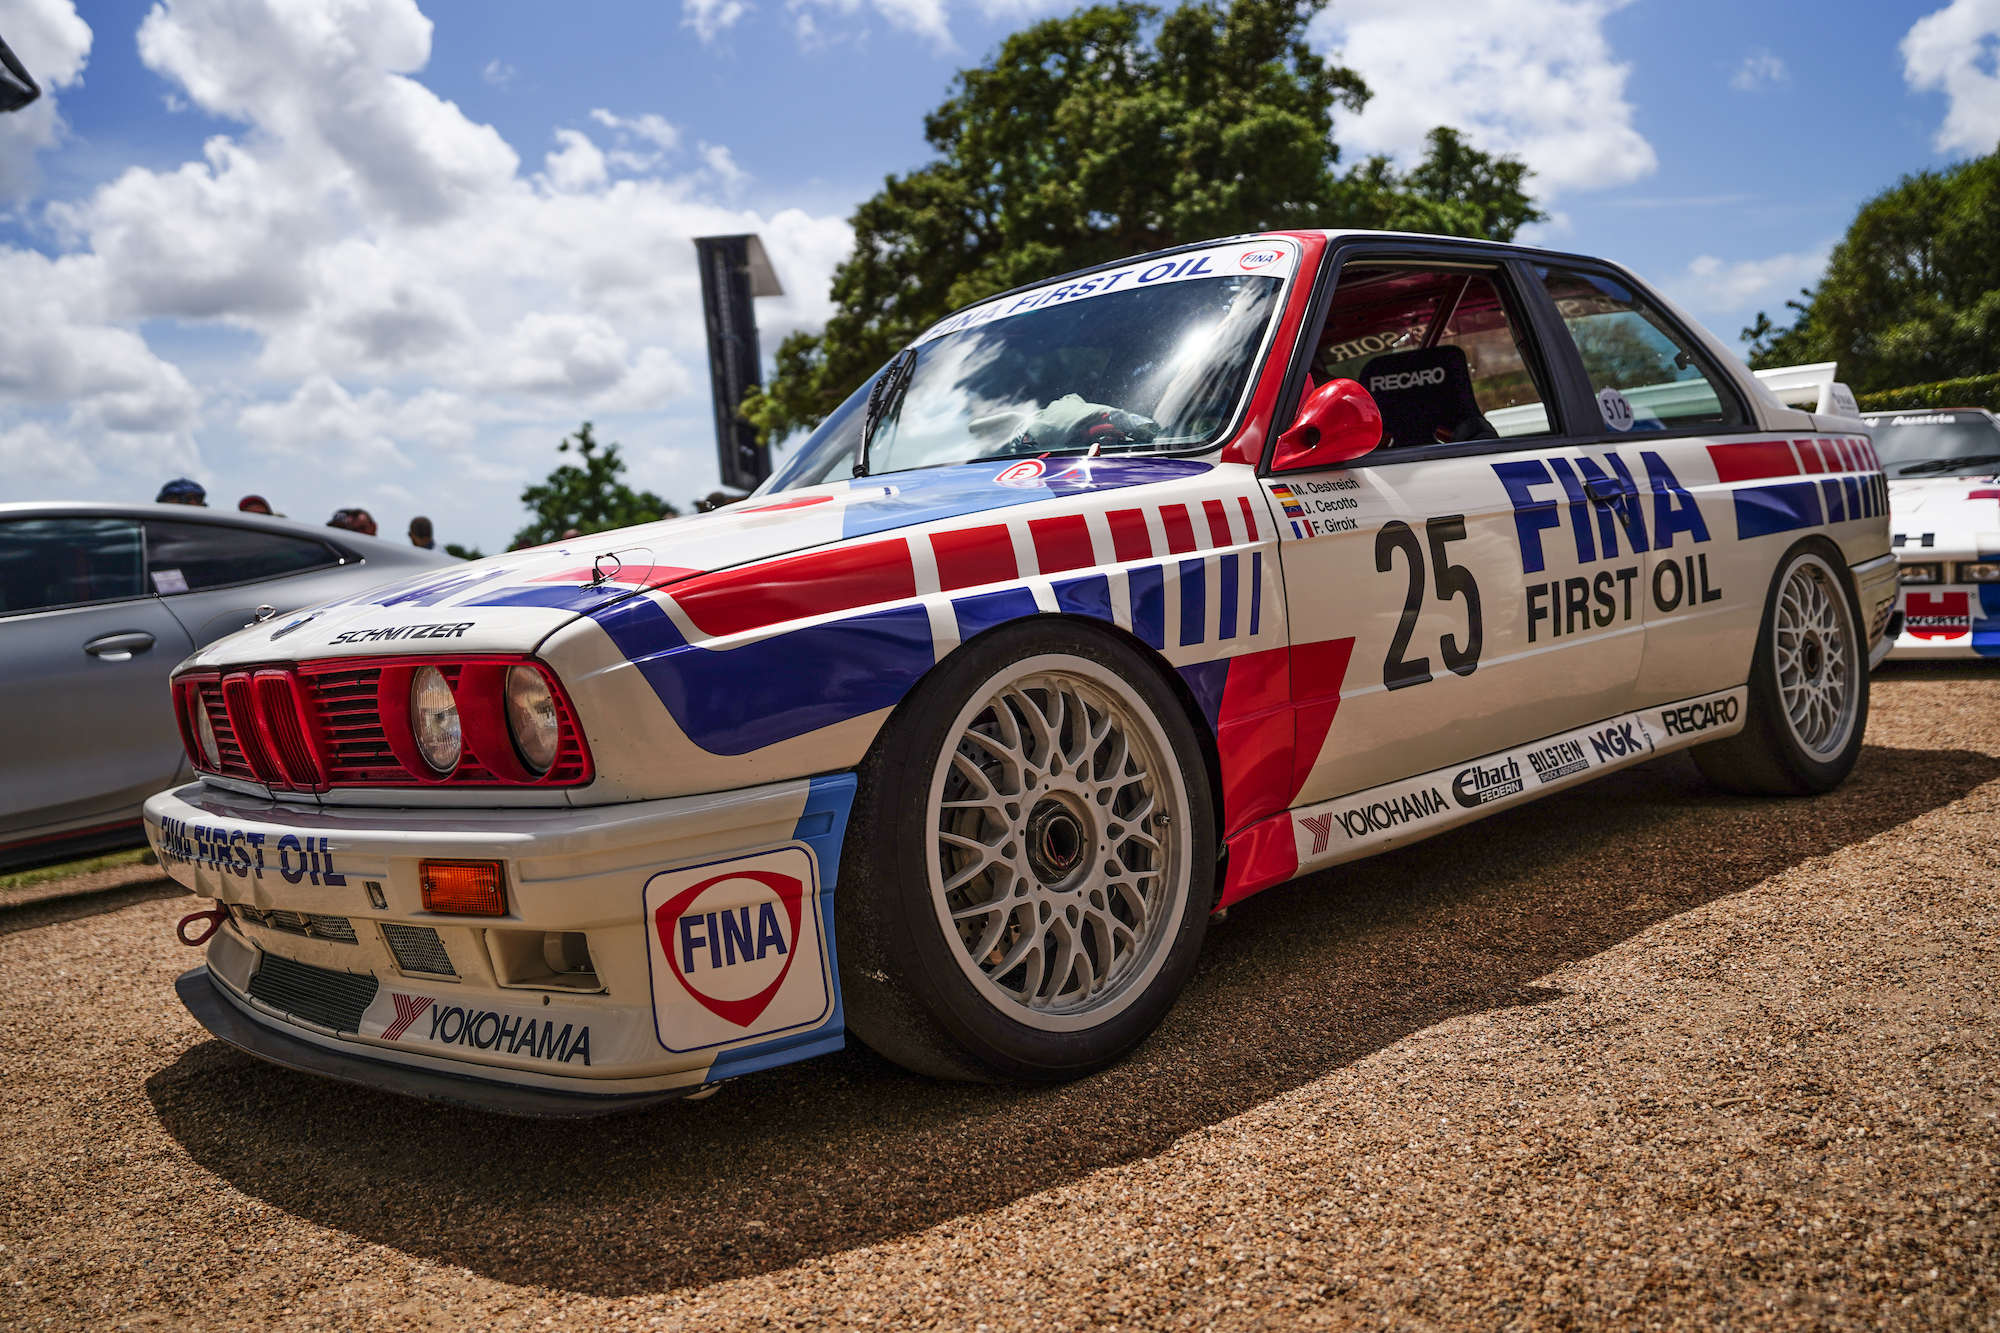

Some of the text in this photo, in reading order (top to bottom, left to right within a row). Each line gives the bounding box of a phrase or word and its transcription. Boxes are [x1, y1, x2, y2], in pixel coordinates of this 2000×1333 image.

[1242, 255, 1274, 263] FINA
[920, 256, 1214, 343] FINA FIRST OIL
[1369, 366, 1446, 392] RECARO
[1603, 398, 1630, 420] 512
[1890, 413, 1956, 426] Austria
[1289, 477, 1360, 496] M. Oestreich
[1304, 497, 1358, 515] J. Cecotto
[1490, 450, 1712, 575] FINA
[1311, 516, 1358, 535] F. Giroix
[1374, 513, 1483, 692] 25
[1525, 552, 1723, 644] FIRST OIL
[328, 622, 476, 646] SCHNITZER
[1661, 696, 1739, 737] RECARO
[1527, 739, 1585, 774] BILSTEIN
[1587, 721, 1643, 763] NGK
[1452, 756, 1521, 809] Eibach
[1480, 780, 1522, 804] FEDERN
[1539, 767, 1561, 784] SHOCK
[1334, 787, 1450, 839] YOKOHAMA
[161, 815, 347, 887] FINA FIRST OIL
[679, 901, 788, 974] FINA
[429, 1004, 591, 1066] YOKOHAMA
